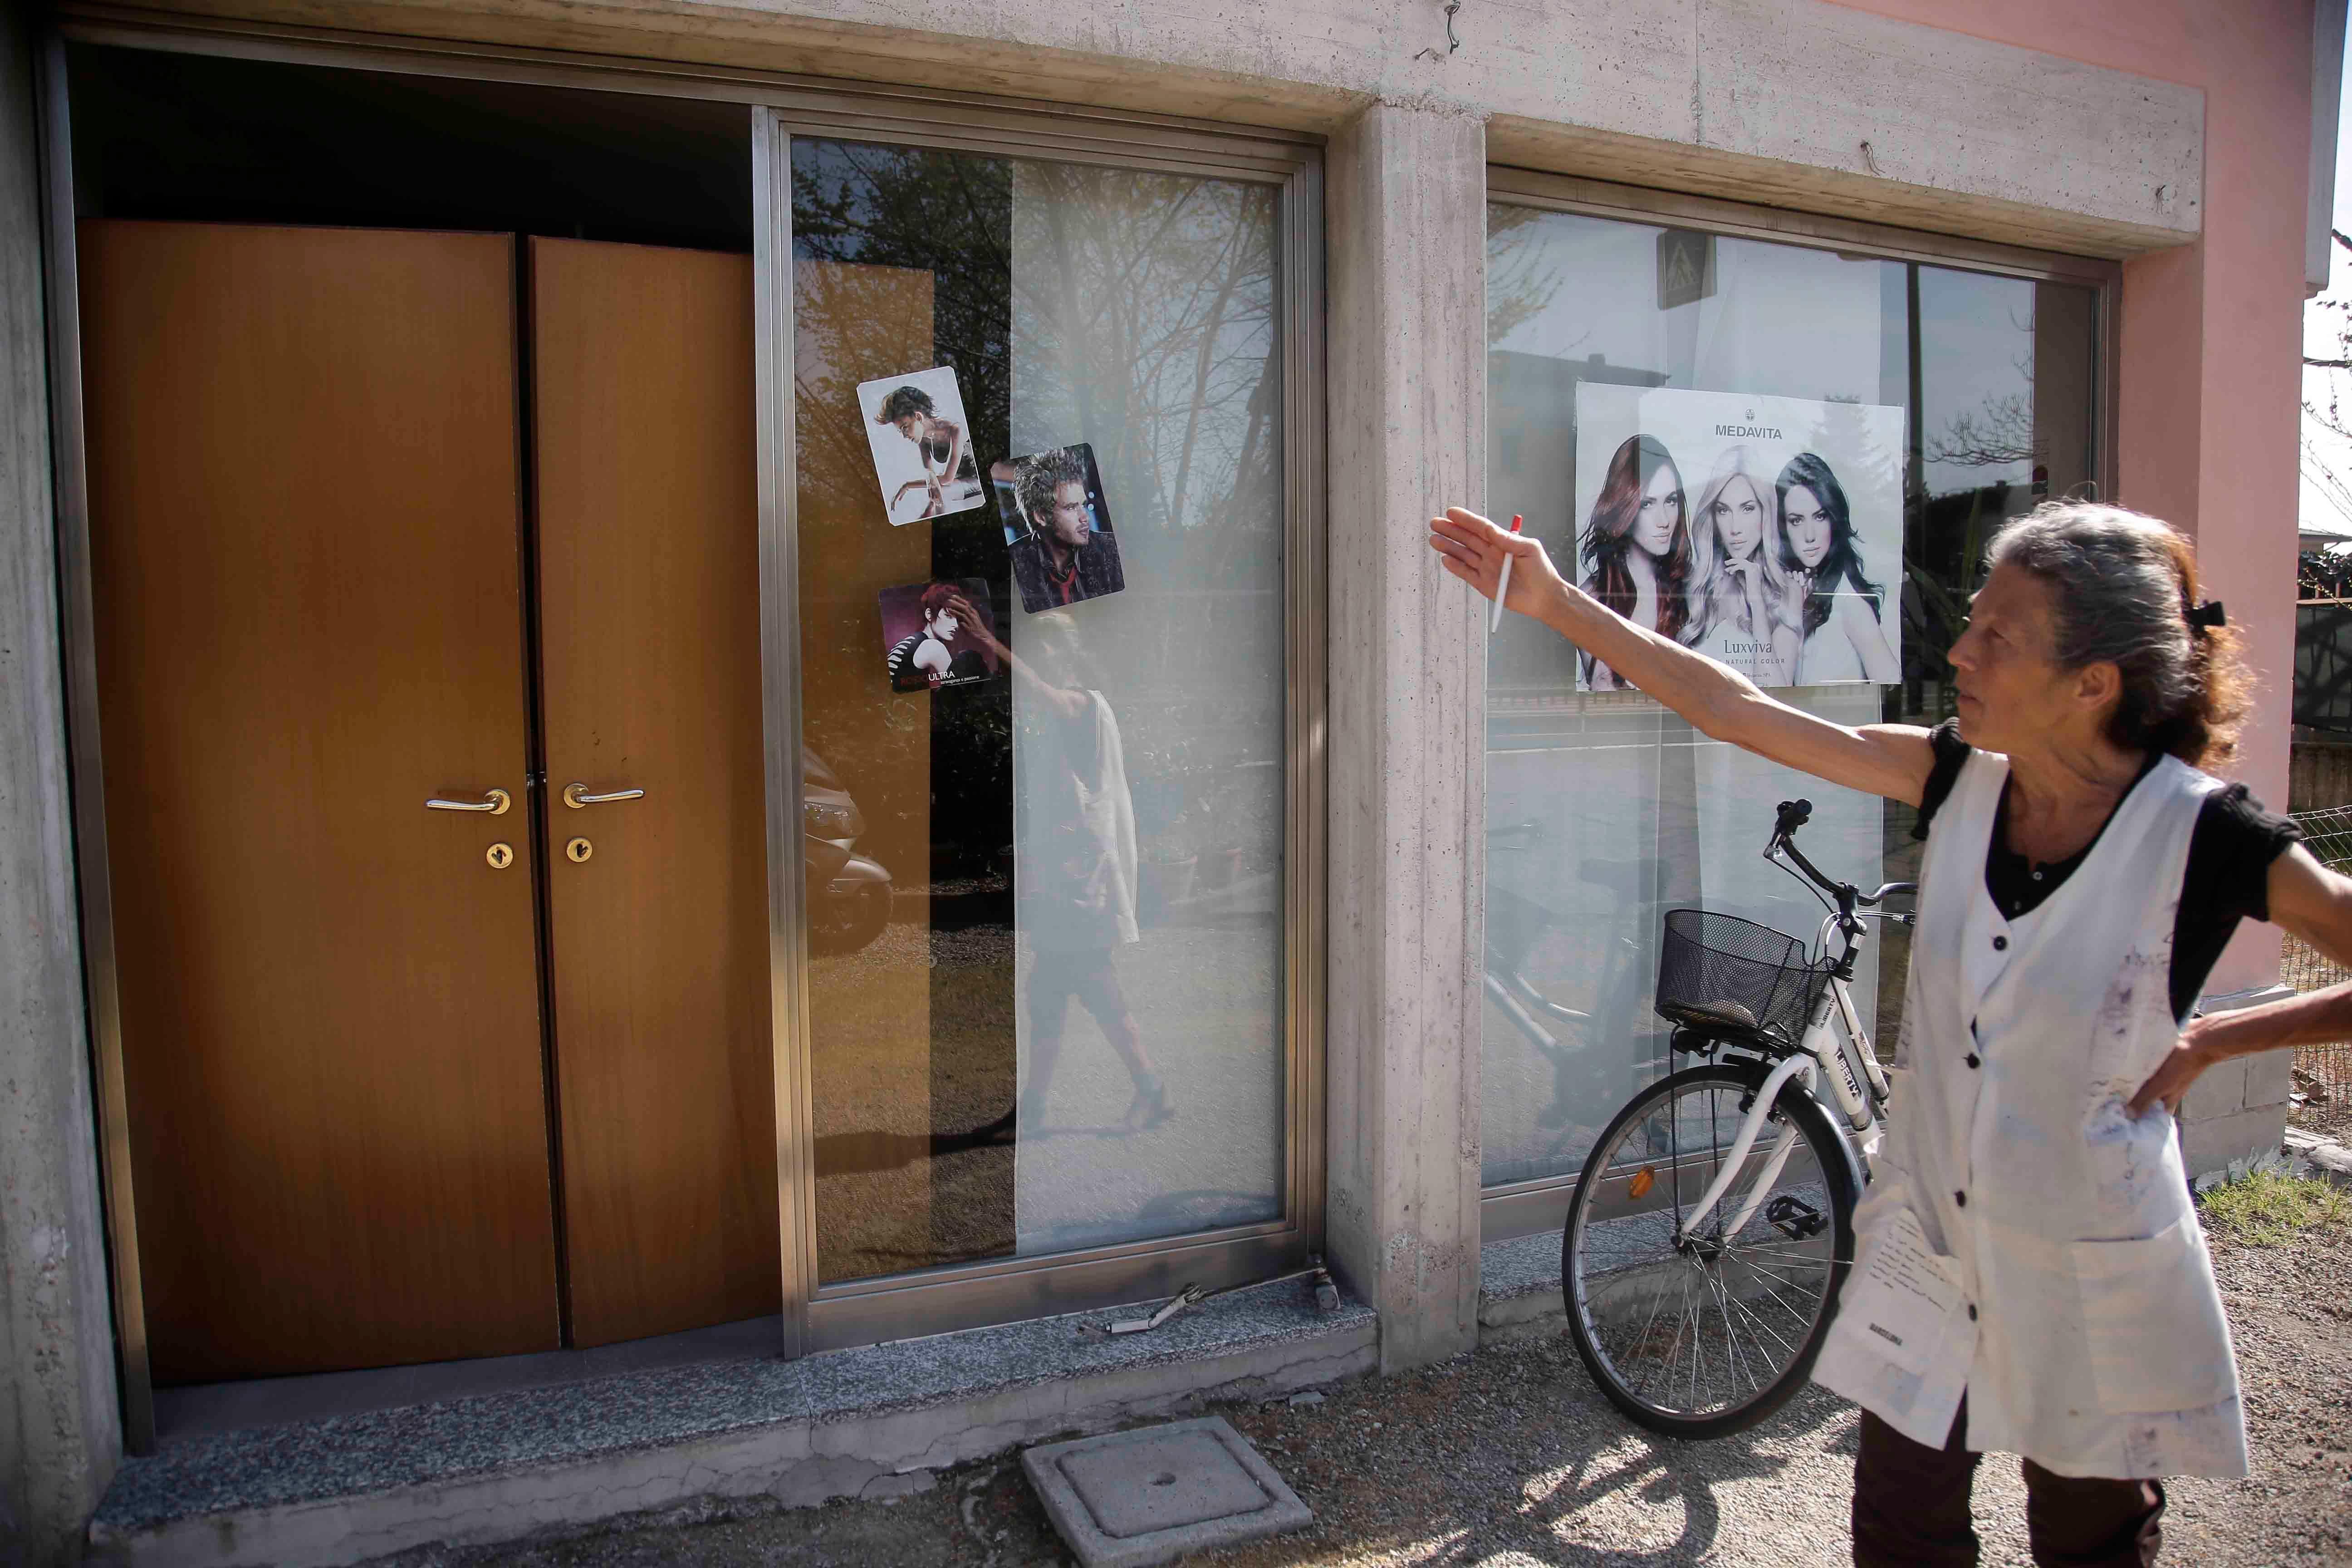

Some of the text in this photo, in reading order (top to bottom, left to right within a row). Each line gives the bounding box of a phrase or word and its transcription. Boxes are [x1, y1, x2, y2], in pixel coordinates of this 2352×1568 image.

[1715, 425, 1782, 440] MEDAVITA
[1724, 639, 1772, 654] Luxviva
[928, 670, 956, 681] ULTRA
[1835, 1050, 1859, 1097] LIBERTY
